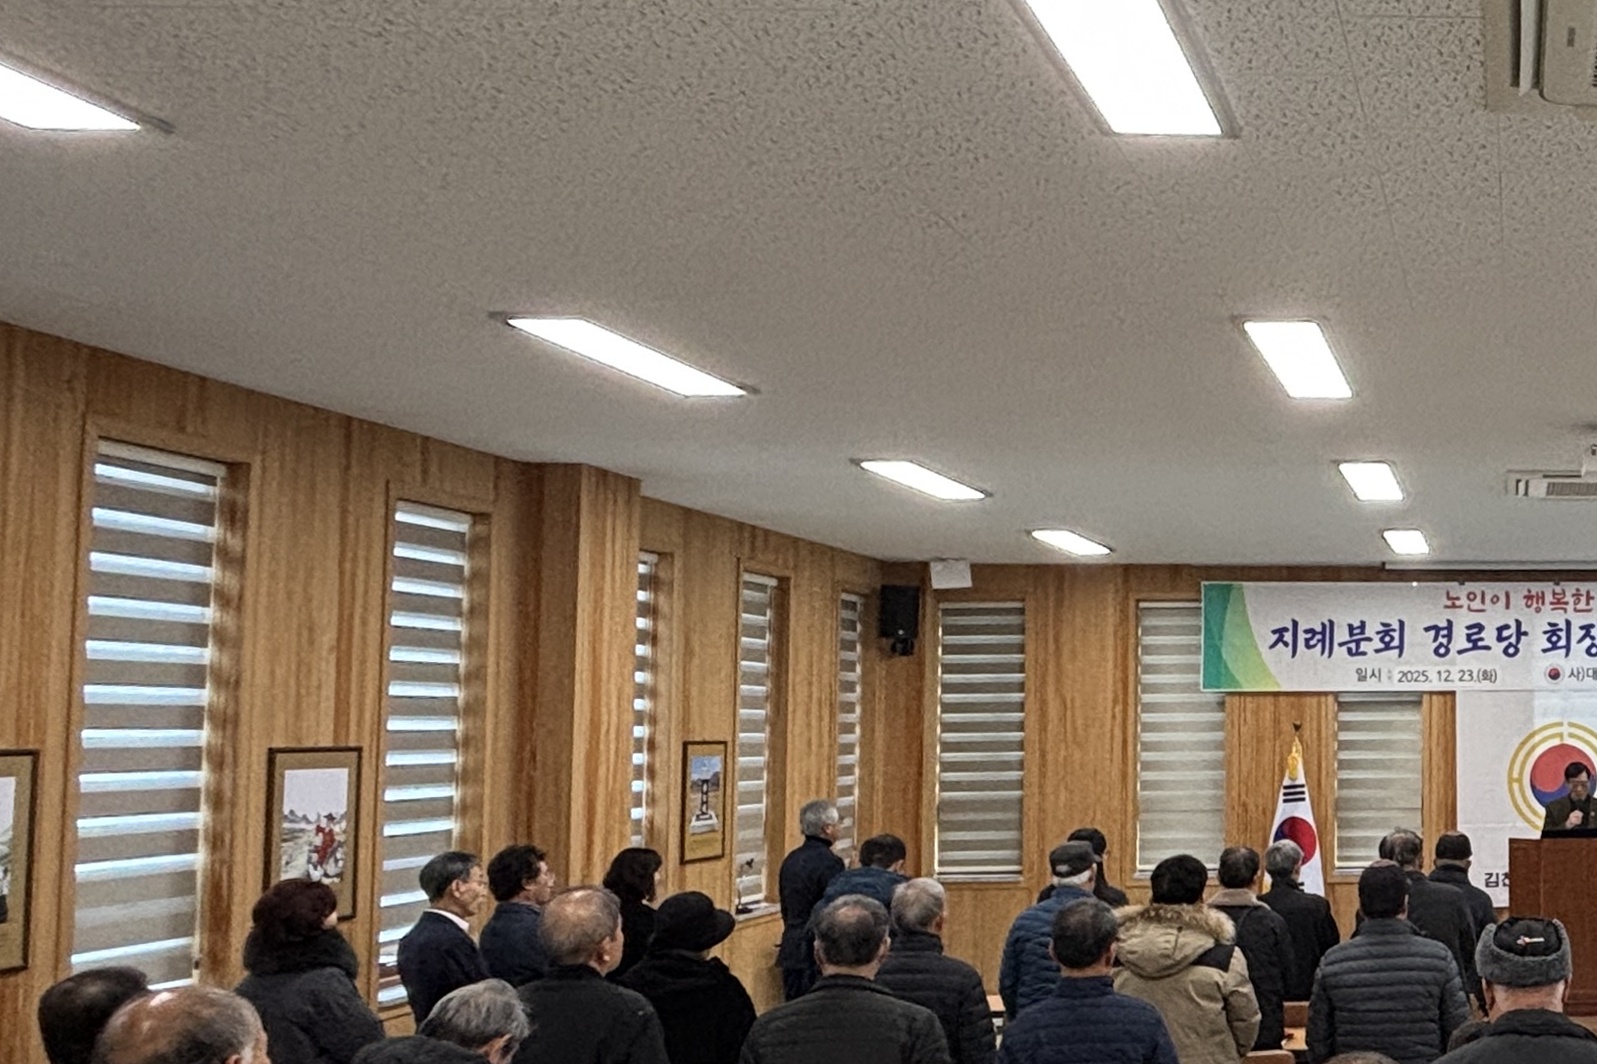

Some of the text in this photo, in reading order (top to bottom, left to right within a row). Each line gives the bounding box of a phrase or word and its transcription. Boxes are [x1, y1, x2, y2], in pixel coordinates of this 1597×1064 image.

[1443, 589, 1511, 613] 노인이
[1523, 588, 1594, 614] 행복한
[1268, 617, 1406, 659] 지례분회
[1423, 617, 1529, 658] 경로당
[1355, 667, 1382, 683] 일시
